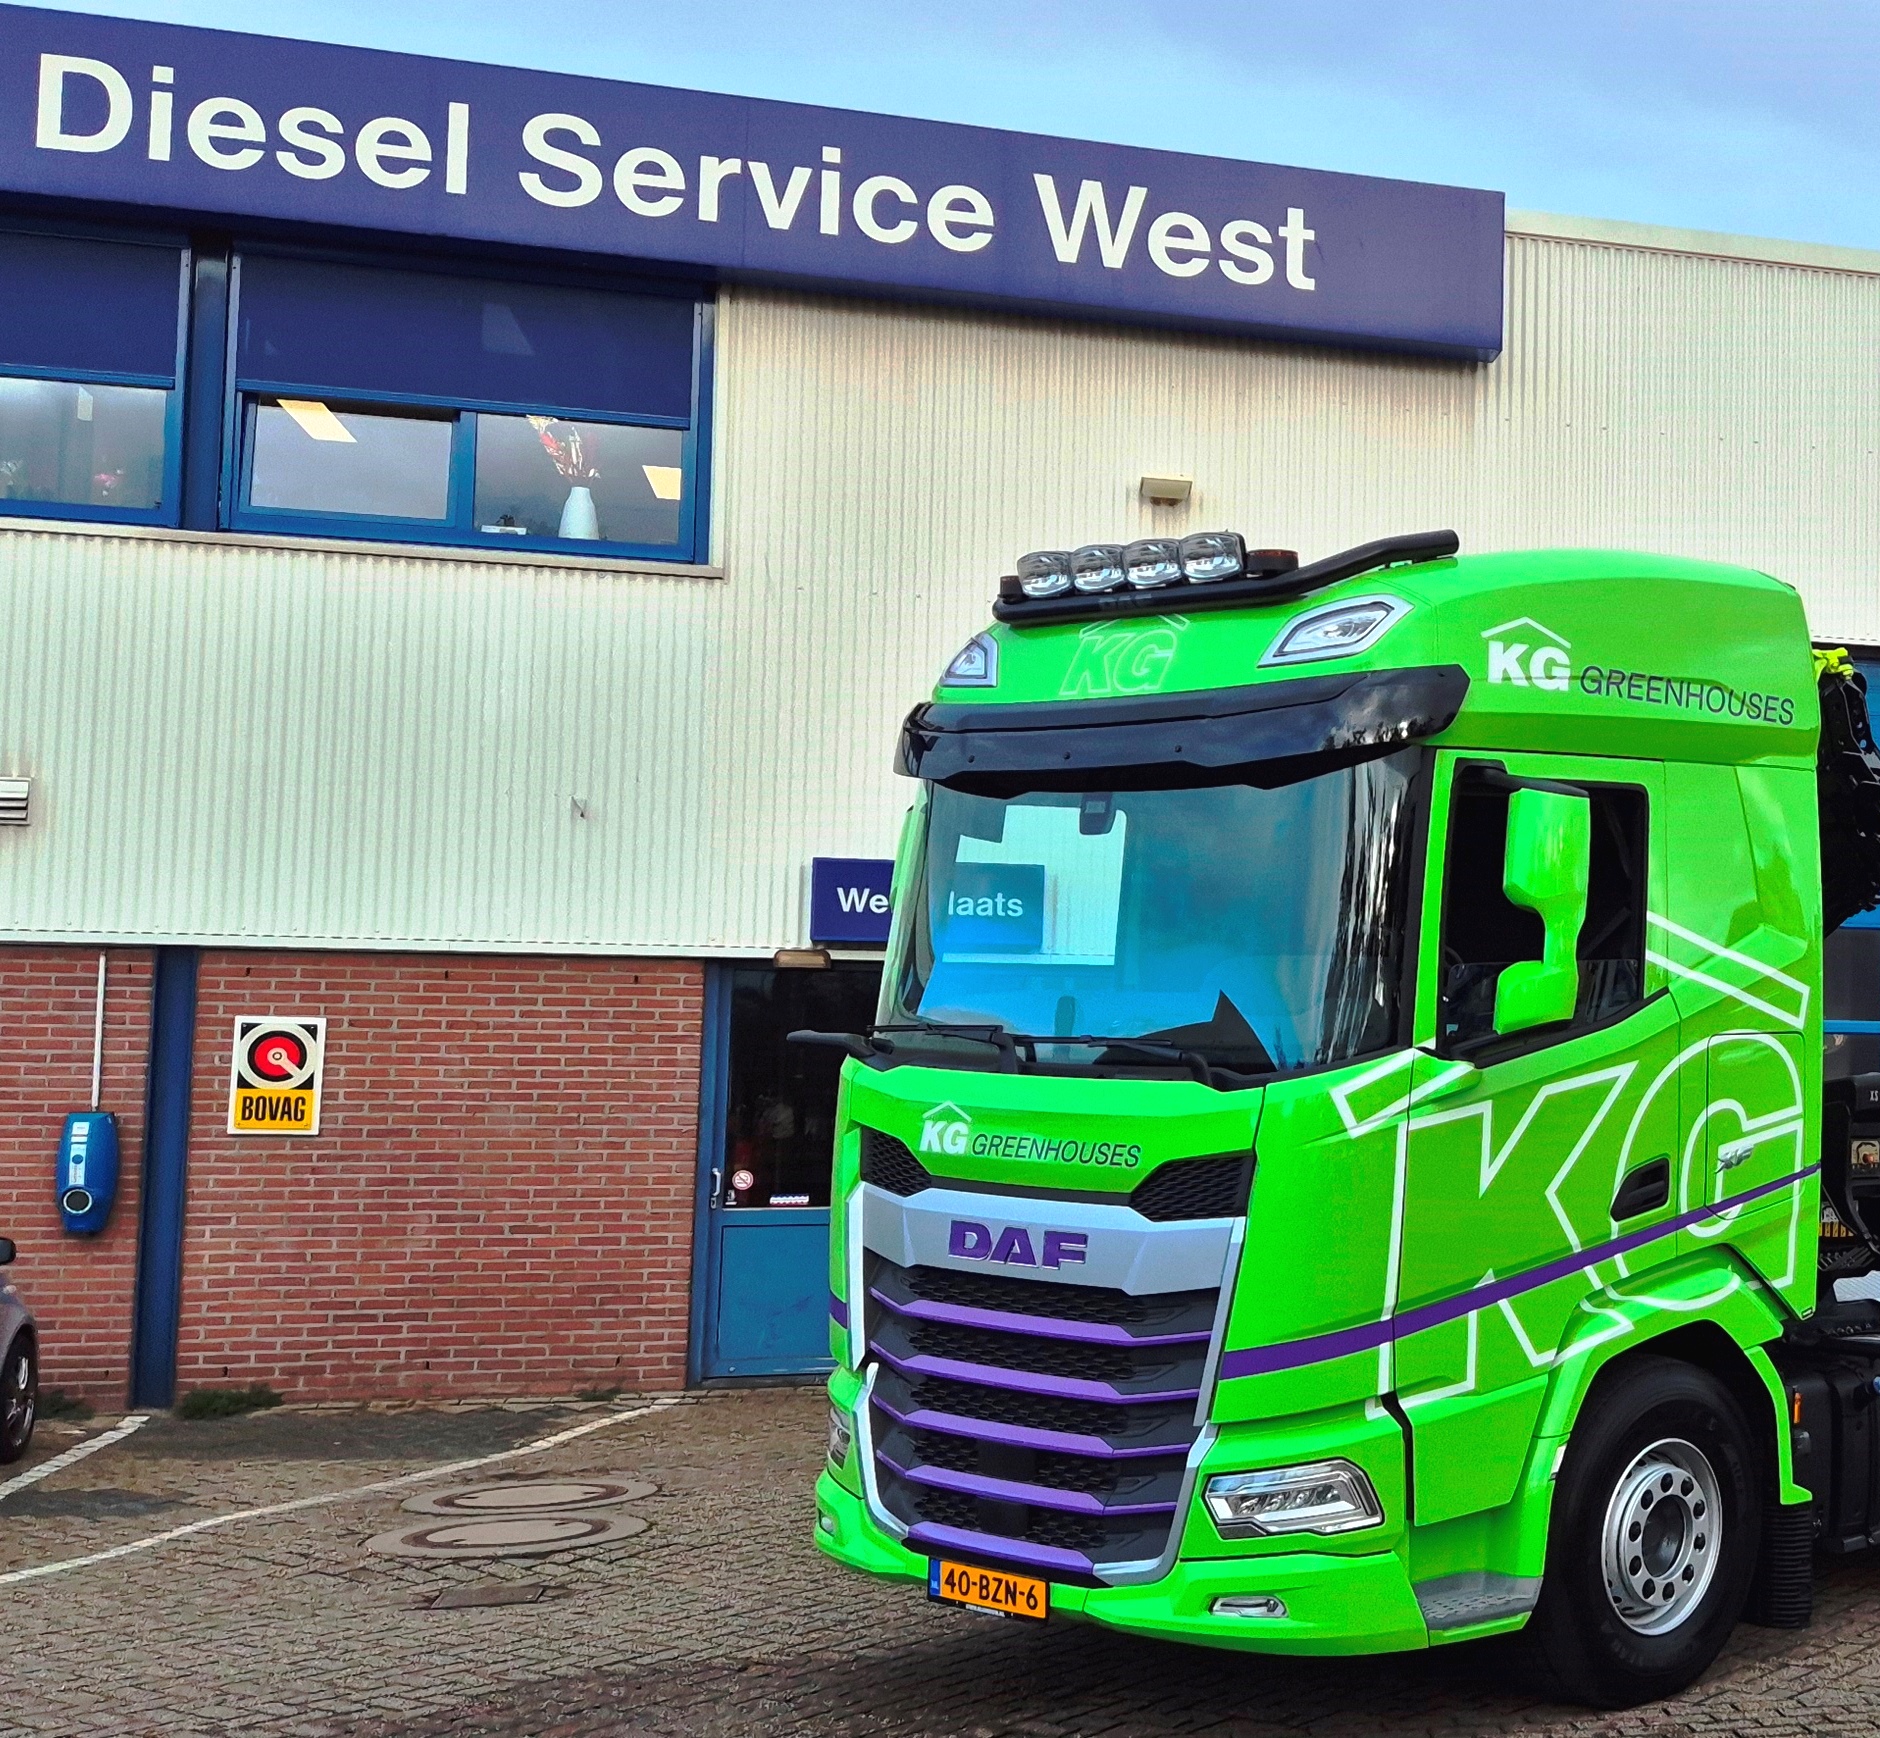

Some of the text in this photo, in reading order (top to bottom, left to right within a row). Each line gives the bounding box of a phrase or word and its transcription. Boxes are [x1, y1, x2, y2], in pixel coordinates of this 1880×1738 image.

[35, 52, 1318, 291] Diesel Service West
[1059, 628, 1178, 696] KG
[1487, 640, 1796, 726] KG GREENHOUSES
[836, 886, 1024, 918] Welaats
[241, 1095, 306, 1122] BOVAG
[919, 1119, 1142, 1168] KG GREENHOUSES
[949, 1219, 1089, 1270] DAF
[1366, 1029, 1804, 1420] KG
[944, 1568, 1039, 1611] 40-BZN-6
